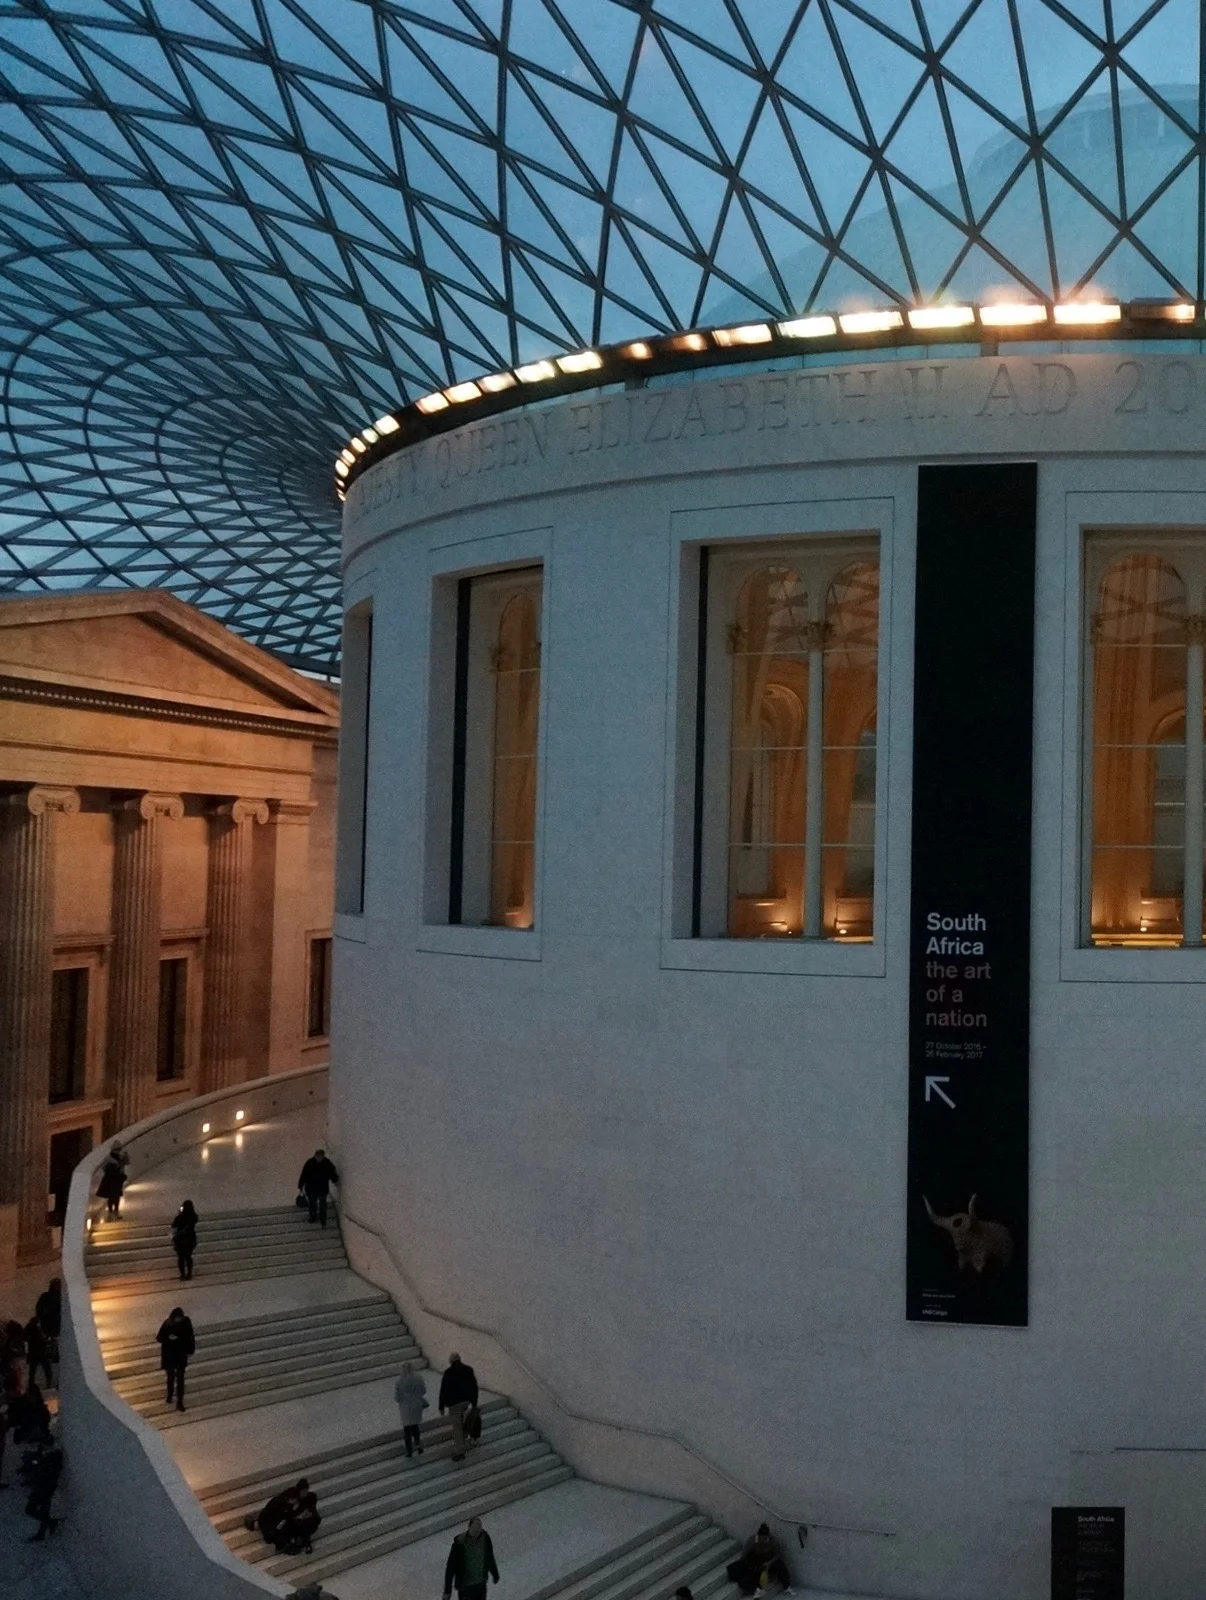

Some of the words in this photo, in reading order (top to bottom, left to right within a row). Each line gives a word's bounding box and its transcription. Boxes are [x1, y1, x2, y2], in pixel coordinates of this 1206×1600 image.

[434, 410, 553, 490] QUEEN
[568, 368, 880, 456] ELIZABETH
[903, 364, 951, 420] II
[974, 362, 1078, 418] AD
[926, 912, 987, 932] South
[925, 936, 985, 955] Africa
[925, 961, 958, 979] the
[963, 962, 992, 979] art
[925, 985, 946, 1003] of
[951, 989, 963, 1003] a
[925, 1009, 988, 1027] nation
